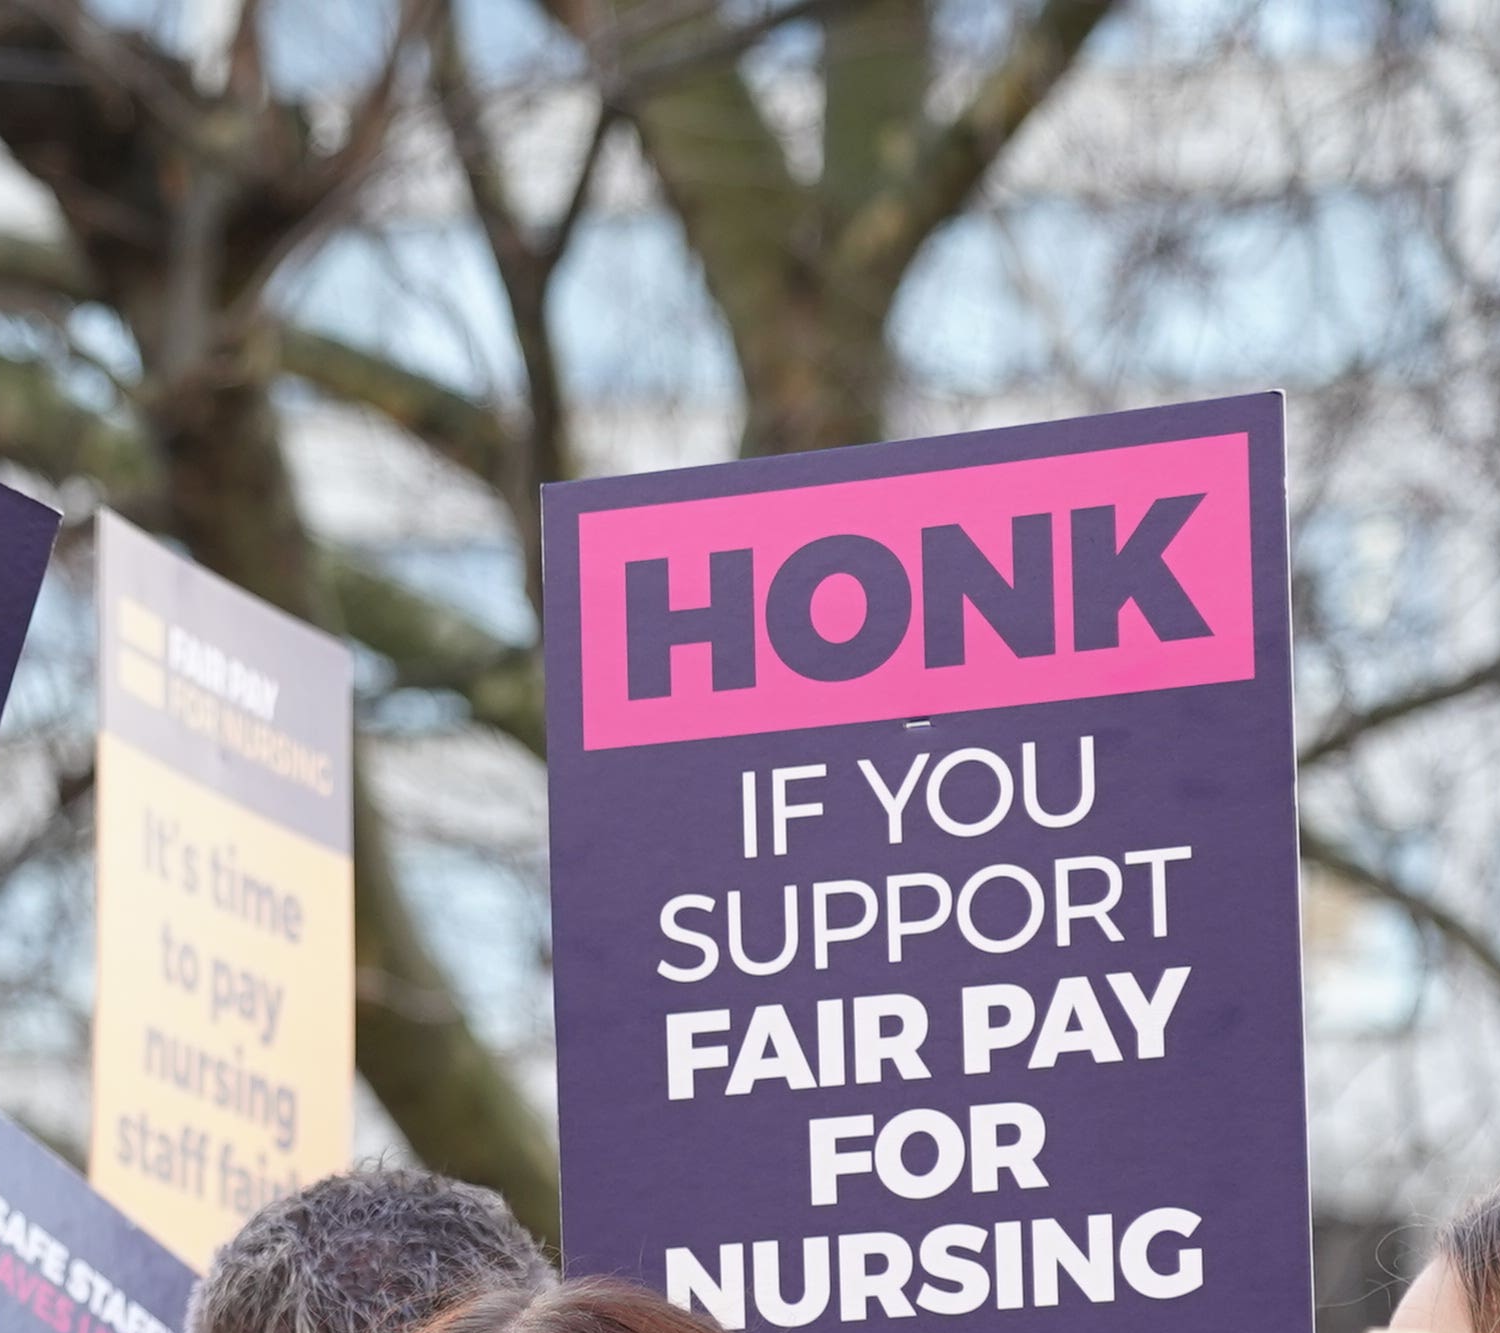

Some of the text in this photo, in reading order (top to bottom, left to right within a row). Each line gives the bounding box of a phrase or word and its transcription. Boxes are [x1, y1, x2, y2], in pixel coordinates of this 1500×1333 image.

[625, 492, 1215, 701] HONK
[168, 624, 280, 722] FAIR PAY
[220, 702, 334, 797] NURSING
[742, 735, 1096, 859] IF YOU
[209, 844, 305, 946] time
[656, 845, 1193, 983] SUPPORT
[160, 922, 286, 1045] to pay
[665, 965, 1193, 1101] FAIR PAY
[144, 1024, 298, 1150] nursing
[116, 1112, 208, 1197] staff
[808, 1101, 1050, 1206] FOR
[664, 1206, 1204, 1332] NURSING
